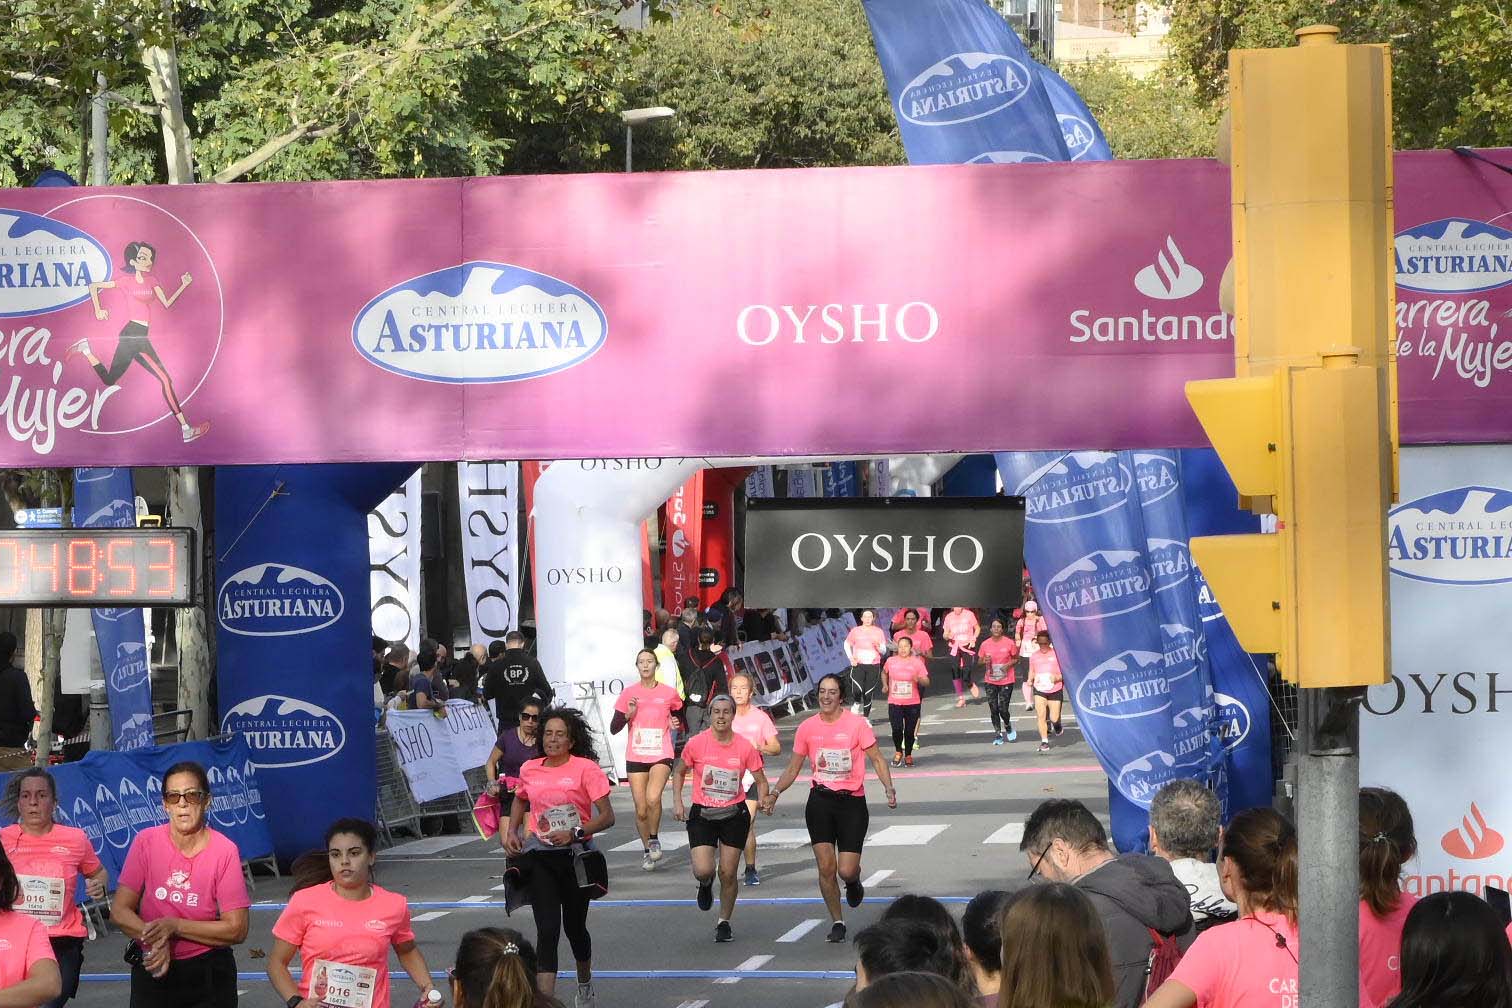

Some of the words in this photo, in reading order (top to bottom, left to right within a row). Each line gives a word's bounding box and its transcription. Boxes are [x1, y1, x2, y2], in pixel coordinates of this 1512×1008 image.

[15, 244, 87, 257] LECHERA
[412, 304, 491, 318] CENTRAL
[736, 300, 940, 346] OYSHO
[373, 307, 587, 353] ASTURIANA
[1416, 520, 1483, 531] CENTRAL
[791, 531, 985, 575] OYSHO
[547, 566, 623, 586] OYSHO
[234, 588, 284, 597] CENTRAL
[289, 587, 330, 596] LECHERA
[221, 593, 335, 621] ASTURIANA
[236, 720, 278, 728] CENTRAL
[282, 719, 331, 727] LECHERA
[26, 894, 45, 903] 016
[328, 985, 351, 997] 016
